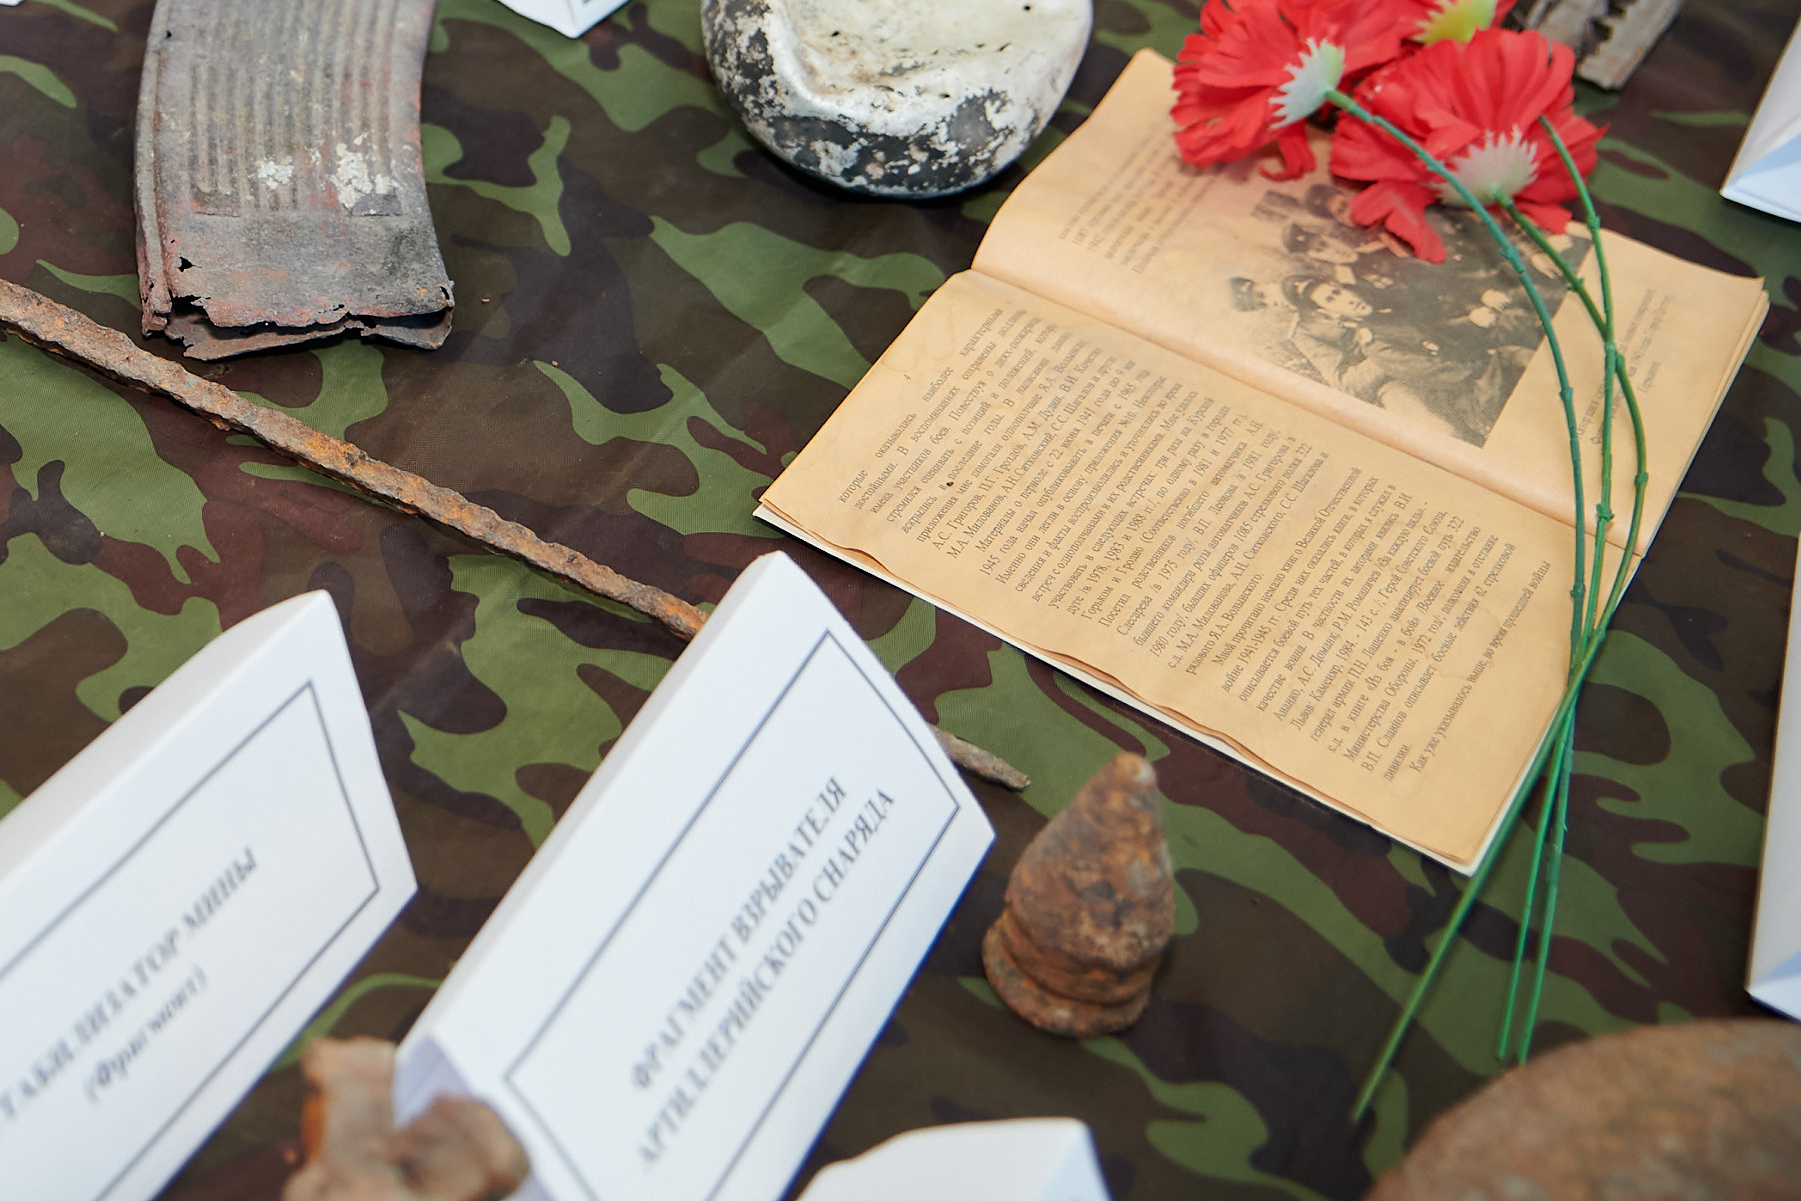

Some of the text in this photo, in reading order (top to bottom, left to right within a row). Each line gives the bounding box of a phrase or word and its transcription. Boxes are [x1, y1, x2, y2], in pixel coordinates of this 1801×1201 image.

[182, 845, 257, 935] МИНЫ
[630, 775, 848, 1091] ФРАГМЕНТ ВЗРЫВАТЕЛЯ
[637, 787, 895, 1171] АРТИЛЛЕРИЙСКОГО СНАРЯДА
